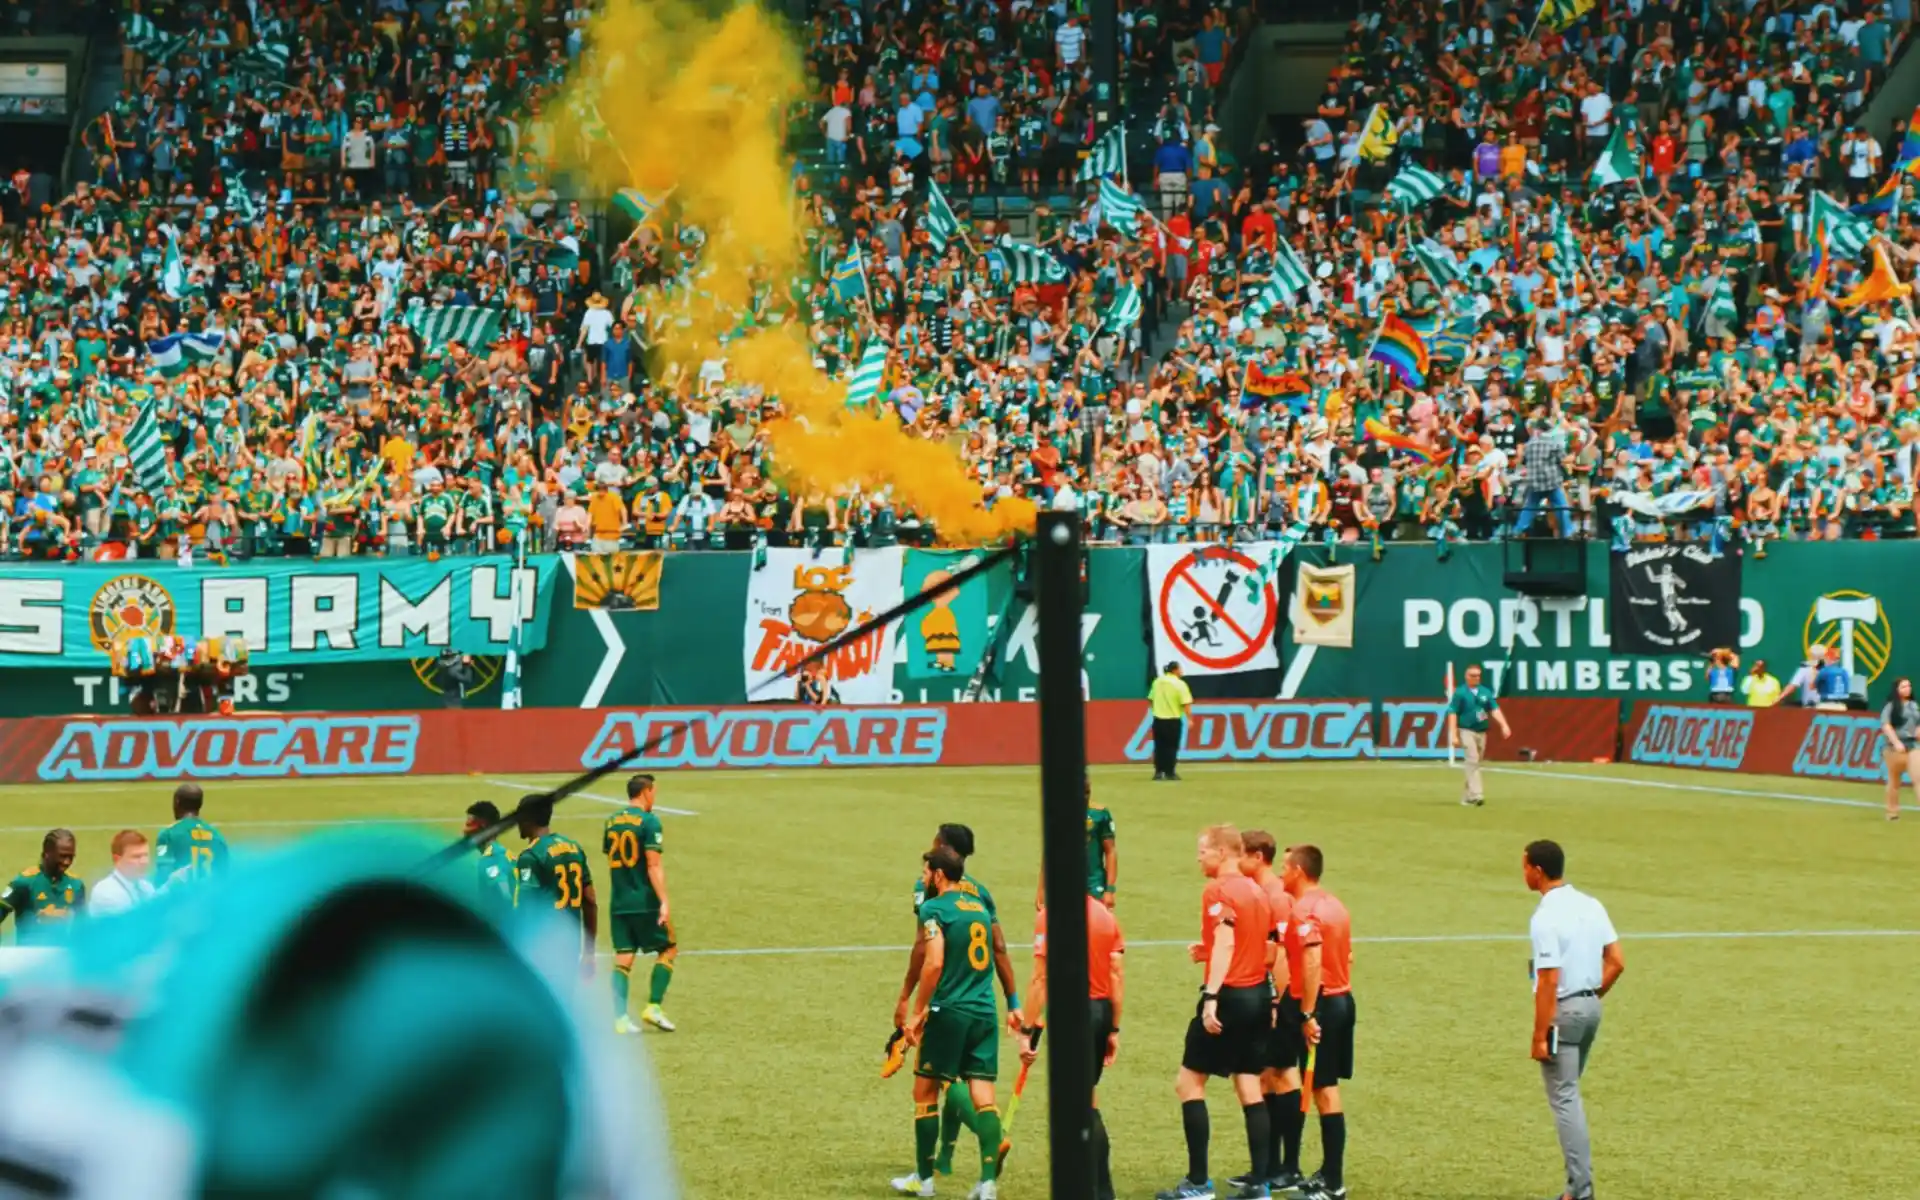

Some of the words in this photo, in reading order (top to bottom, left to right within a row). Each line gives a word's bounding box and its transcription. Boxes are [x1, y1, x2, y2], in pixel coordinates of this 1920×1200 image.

[792, 564, 857, 591] LOG
[201, 566, 537, 653] ARMY
[1403, 598, 1765, 648] PORTLD
[40, 716, 418, 777] ADVOCARE
[585, 711, 944, 767] ADVOCARE
[1128, 706, 1453, 757] DVOCAR
[1633, 707, 1753, 766] ADVOCARE
[607, 830, 638, 869] 20
[554, 861, 583, 910] 33
[967, 921, 990, 971] 8
